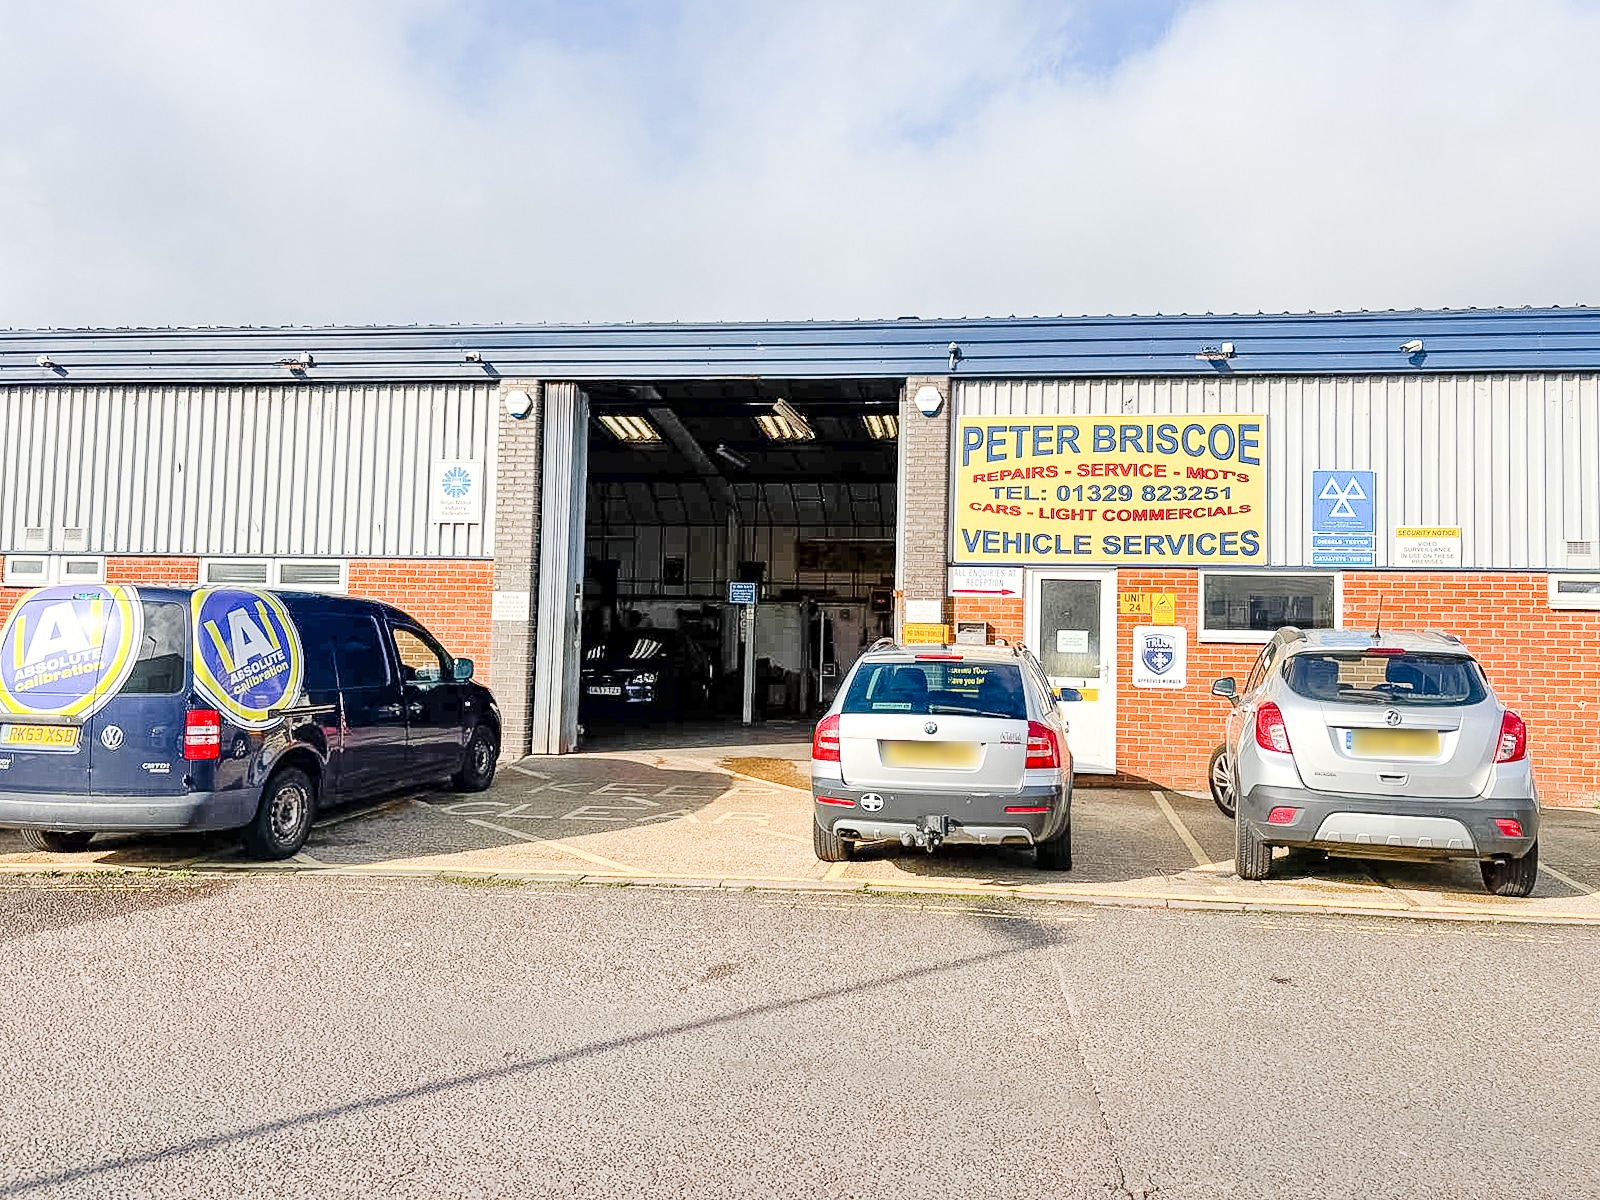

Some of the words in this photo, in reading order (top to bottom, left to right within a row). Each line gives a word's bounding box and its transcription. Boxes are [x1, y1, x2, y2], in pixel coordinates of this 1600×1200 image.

[962, 424, 1081, 467] PETER
[1092, 423, 1260, 466] BRISCOE
[972, 465, 1058, 483] REPAIRS
[1076, 463, 1167, 478] SERVICE
[1186, 467, 1250, 483] MOT'S
[989, 486, 1047, 501] TEL:
[1056, 485, 1133, 502] 01329
[1141, 485, 1232, 502] 823251
[969, 502, 1021, 517] CARS
[1039, 507, 1097, 522] LIGHT
[1102, 504, 1252, 523] COMMERCIALS
[961, 529, 1092, 555] VEHICLE
[1102, 530, 1260, 557] SERVICES
[954, 568, 966, 577] ALL
[969, 568, 1006, 578] ENQUIRIES
[1008, 569, 1017, 578] AT
[965, 578, 1004, 587] RECEPTION
[1124, 593, 1146, 602] UNIT
[1129, 603, 1141, 612] 24
[14, 648, 102, 682] ABSOLUTE
[230, 650, 286, 685] ABSOLUTE
[14, 661, 105, 693] calibration
[233, 661, 289, 694] calibration
[9, 727, 44, 741] RK63
[44, 728, 74, 743] XSB
